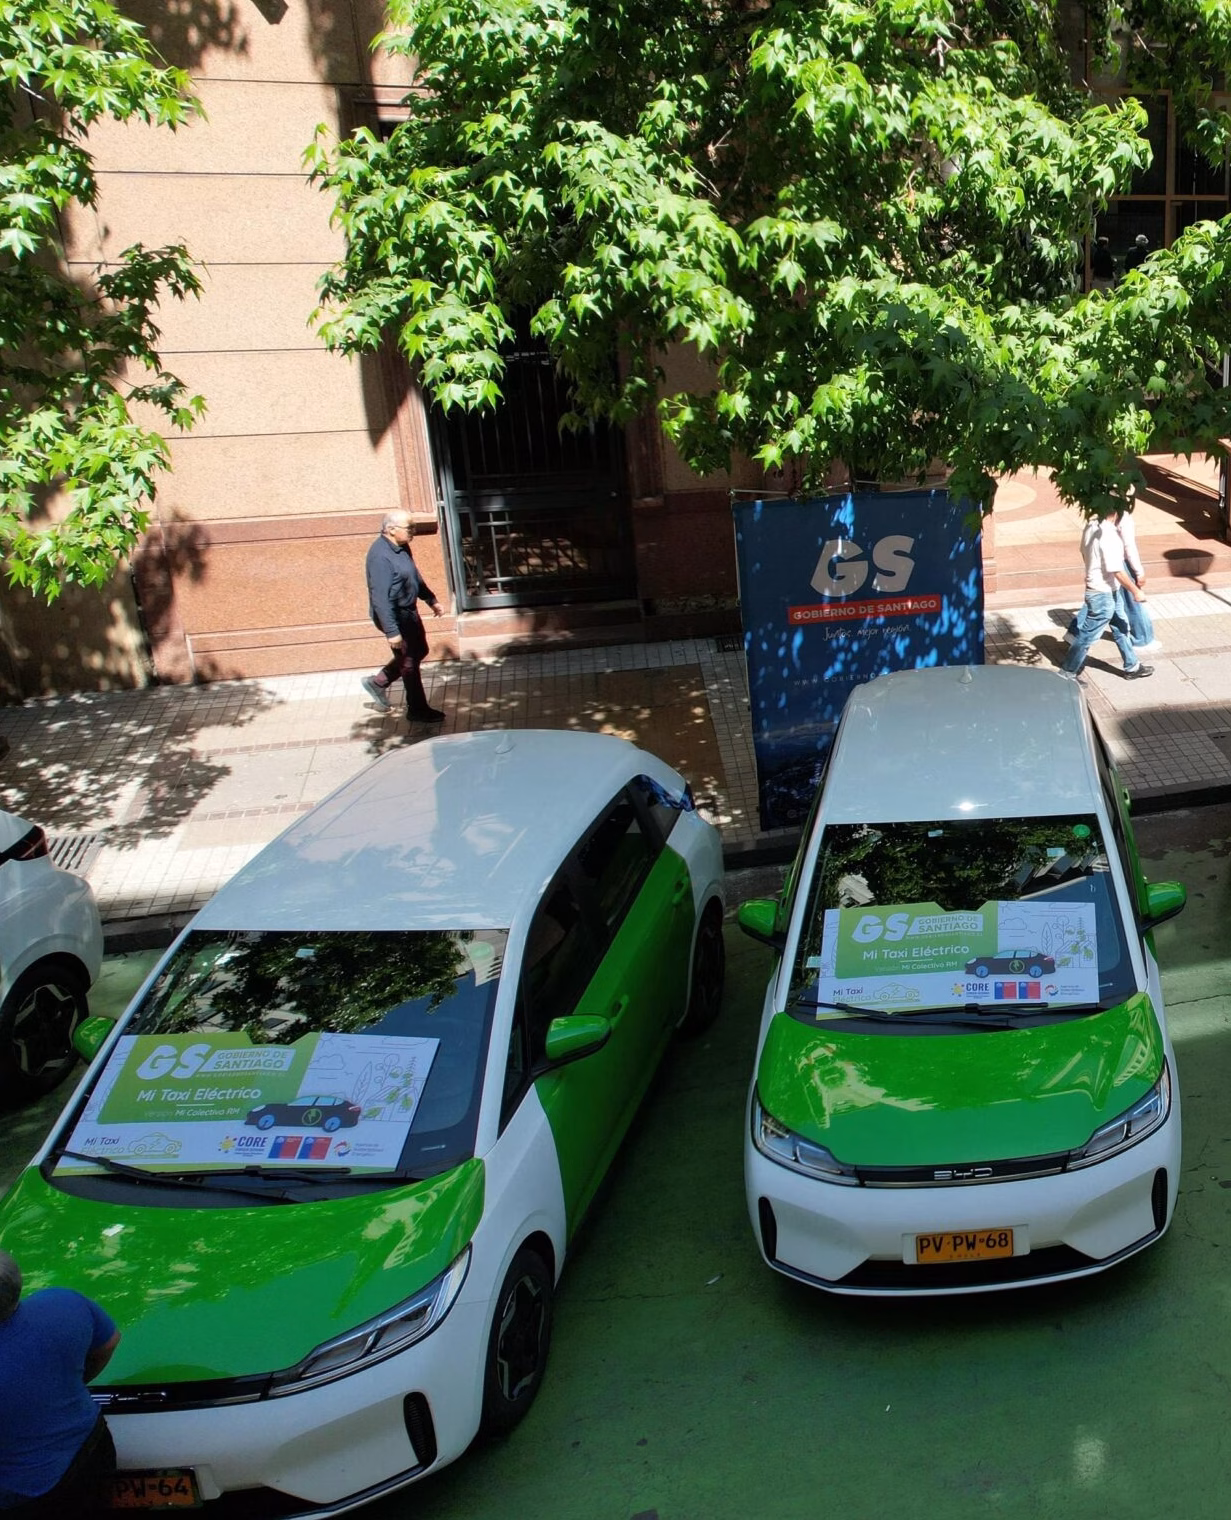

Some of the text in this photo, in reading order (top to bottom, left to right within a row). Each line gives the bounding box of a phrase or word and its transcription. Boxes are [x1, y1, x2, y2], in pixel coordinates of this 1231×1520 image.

[810, 535, 915, 597] GS
[793, 600, 937, 620] GOBIERNO DE SANTIAGO
[857, 627, 878, 640] mejor
[918, 914, 979, 925] GOBIERNO DE
[851, 912, 910, 943] GS
[919, 922, 979, 933] SANTIAGO
[863, 944, 970, 960] Mi Taxi Eléctrico
[912, 962, 945, 970] Colectivo
[846, 986, 864, 995] Taxi
[966, 982, 990, 991] CORE
[217, 1050, 288, 1060] GOBIERNO DE
[136, 1043, 212, 1080] GS
[213, 1058, 284, 1069] SANTIAGO
[136, 1086, 262, 1102] Mi Taxi Eléctrico
[187, 1108, 225, 1117] Colectivo
[85, 1136, 121, 1146] Mi Taxi
[237, 1136, 268, 1148] CORE
[934, 1167, 993, 1180] BYD
